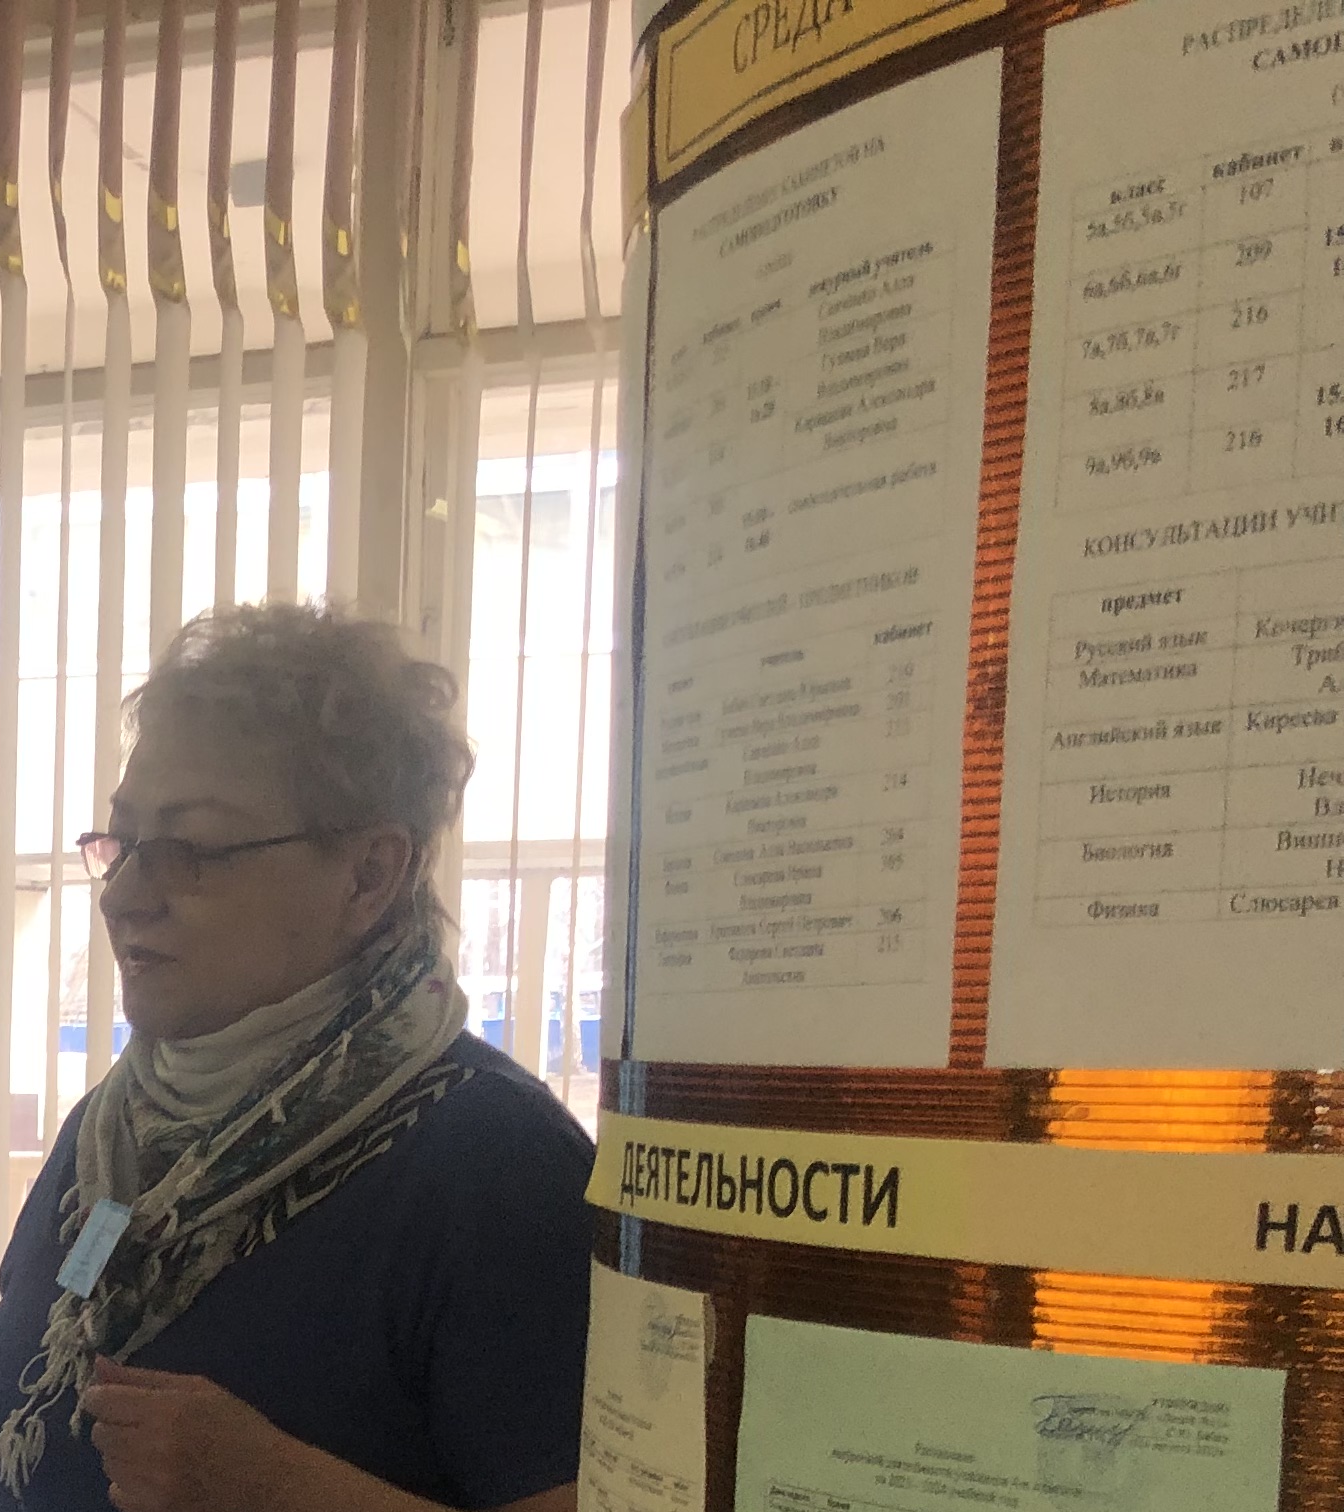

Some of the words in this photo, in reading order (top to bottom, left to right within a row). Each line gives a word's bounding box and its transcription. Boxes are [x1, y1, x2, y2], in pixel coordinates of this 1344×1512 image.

[1213, 145, 1305, 178] кабинет
[1083, 509, 1278, 558] КОНСУЛЬТАЦИИ
[1101, 589, 1183, 616] предмет
[1158, 631, 1208, 649] язык
[1079, 663, 1198, 689] Математика
[1050, 719, 1168, 751] Английский
[1173, 719, 1222, 738] язык
[1089, 783, 1172, 805] История
[1082, 841, 1174, 863] Биология
[1087, 900, 1160, 920] Физика
[620, 1141, 900, 1228] ДЕЯТЕЛЬНОСТИ
